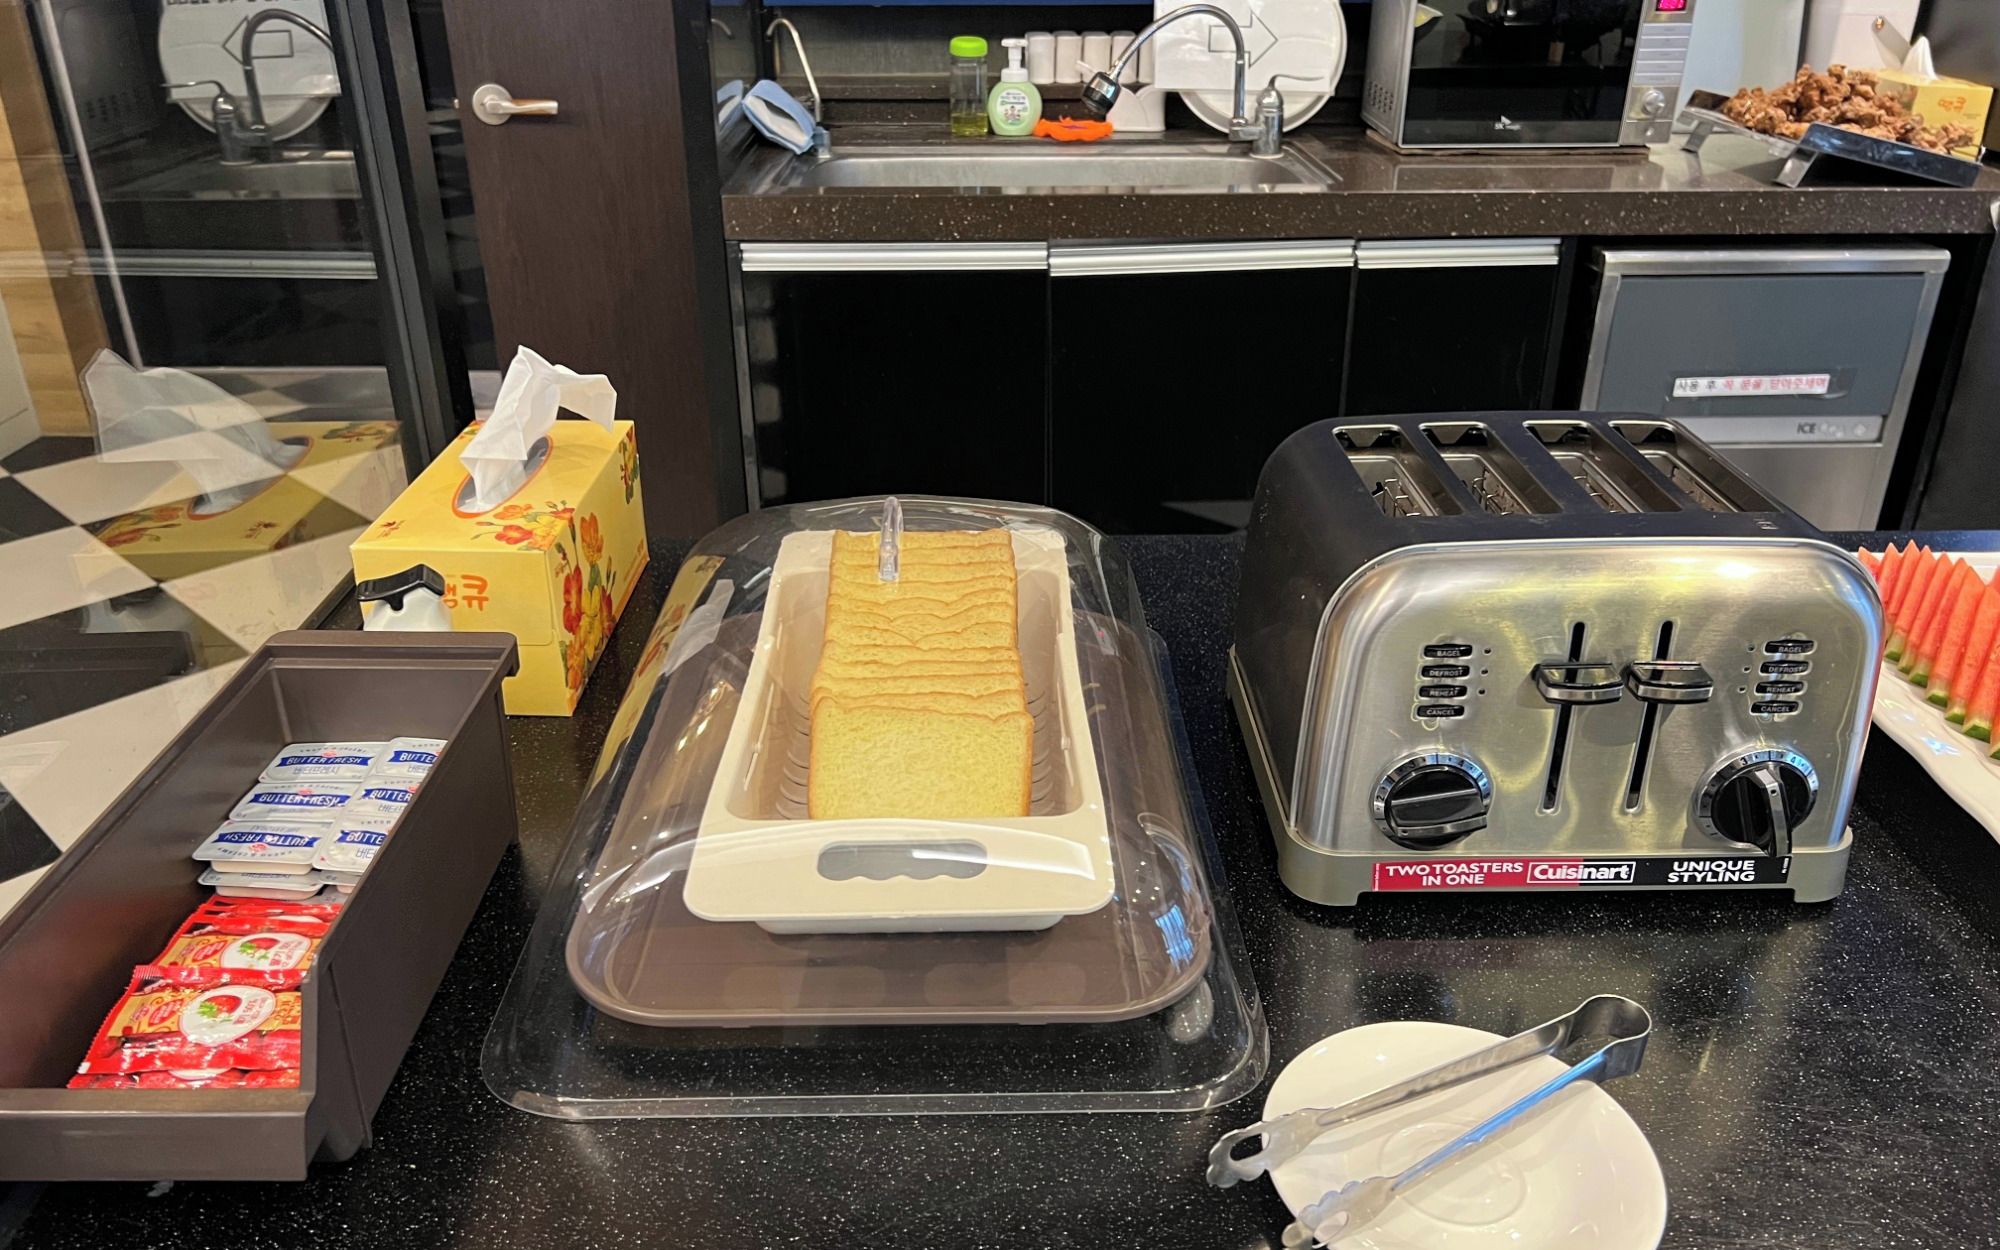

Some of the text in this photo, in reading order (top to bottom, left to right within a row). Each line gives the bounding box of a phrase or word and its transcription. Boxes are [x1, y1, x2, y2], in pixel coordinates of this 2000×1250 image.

[1778, 645, 1802, 653] BAGEL
[1429, 669, 1464, 677] DEFROST
[1768, 665, 1804, 673] DEFROST
[286, 756, 362, 766] BUTTER FRESH
[259, 794, 340, 807] BUTTER FRESH
[223, 832, 307, 847] BUTTER FRESH
[346, 831, 385, 845] BUTTE
[1386, 864, 1430, 877] TWO
[1431, 862, 1523, 875] TOASTERS
[1533, 864, 1631, 880] Cuisinart
[1673, 860, 1756, 872] UNIQUE
[1422, 873, 1485, 886] IN ONE
[1667, 870, 1756, 883] STYLING
